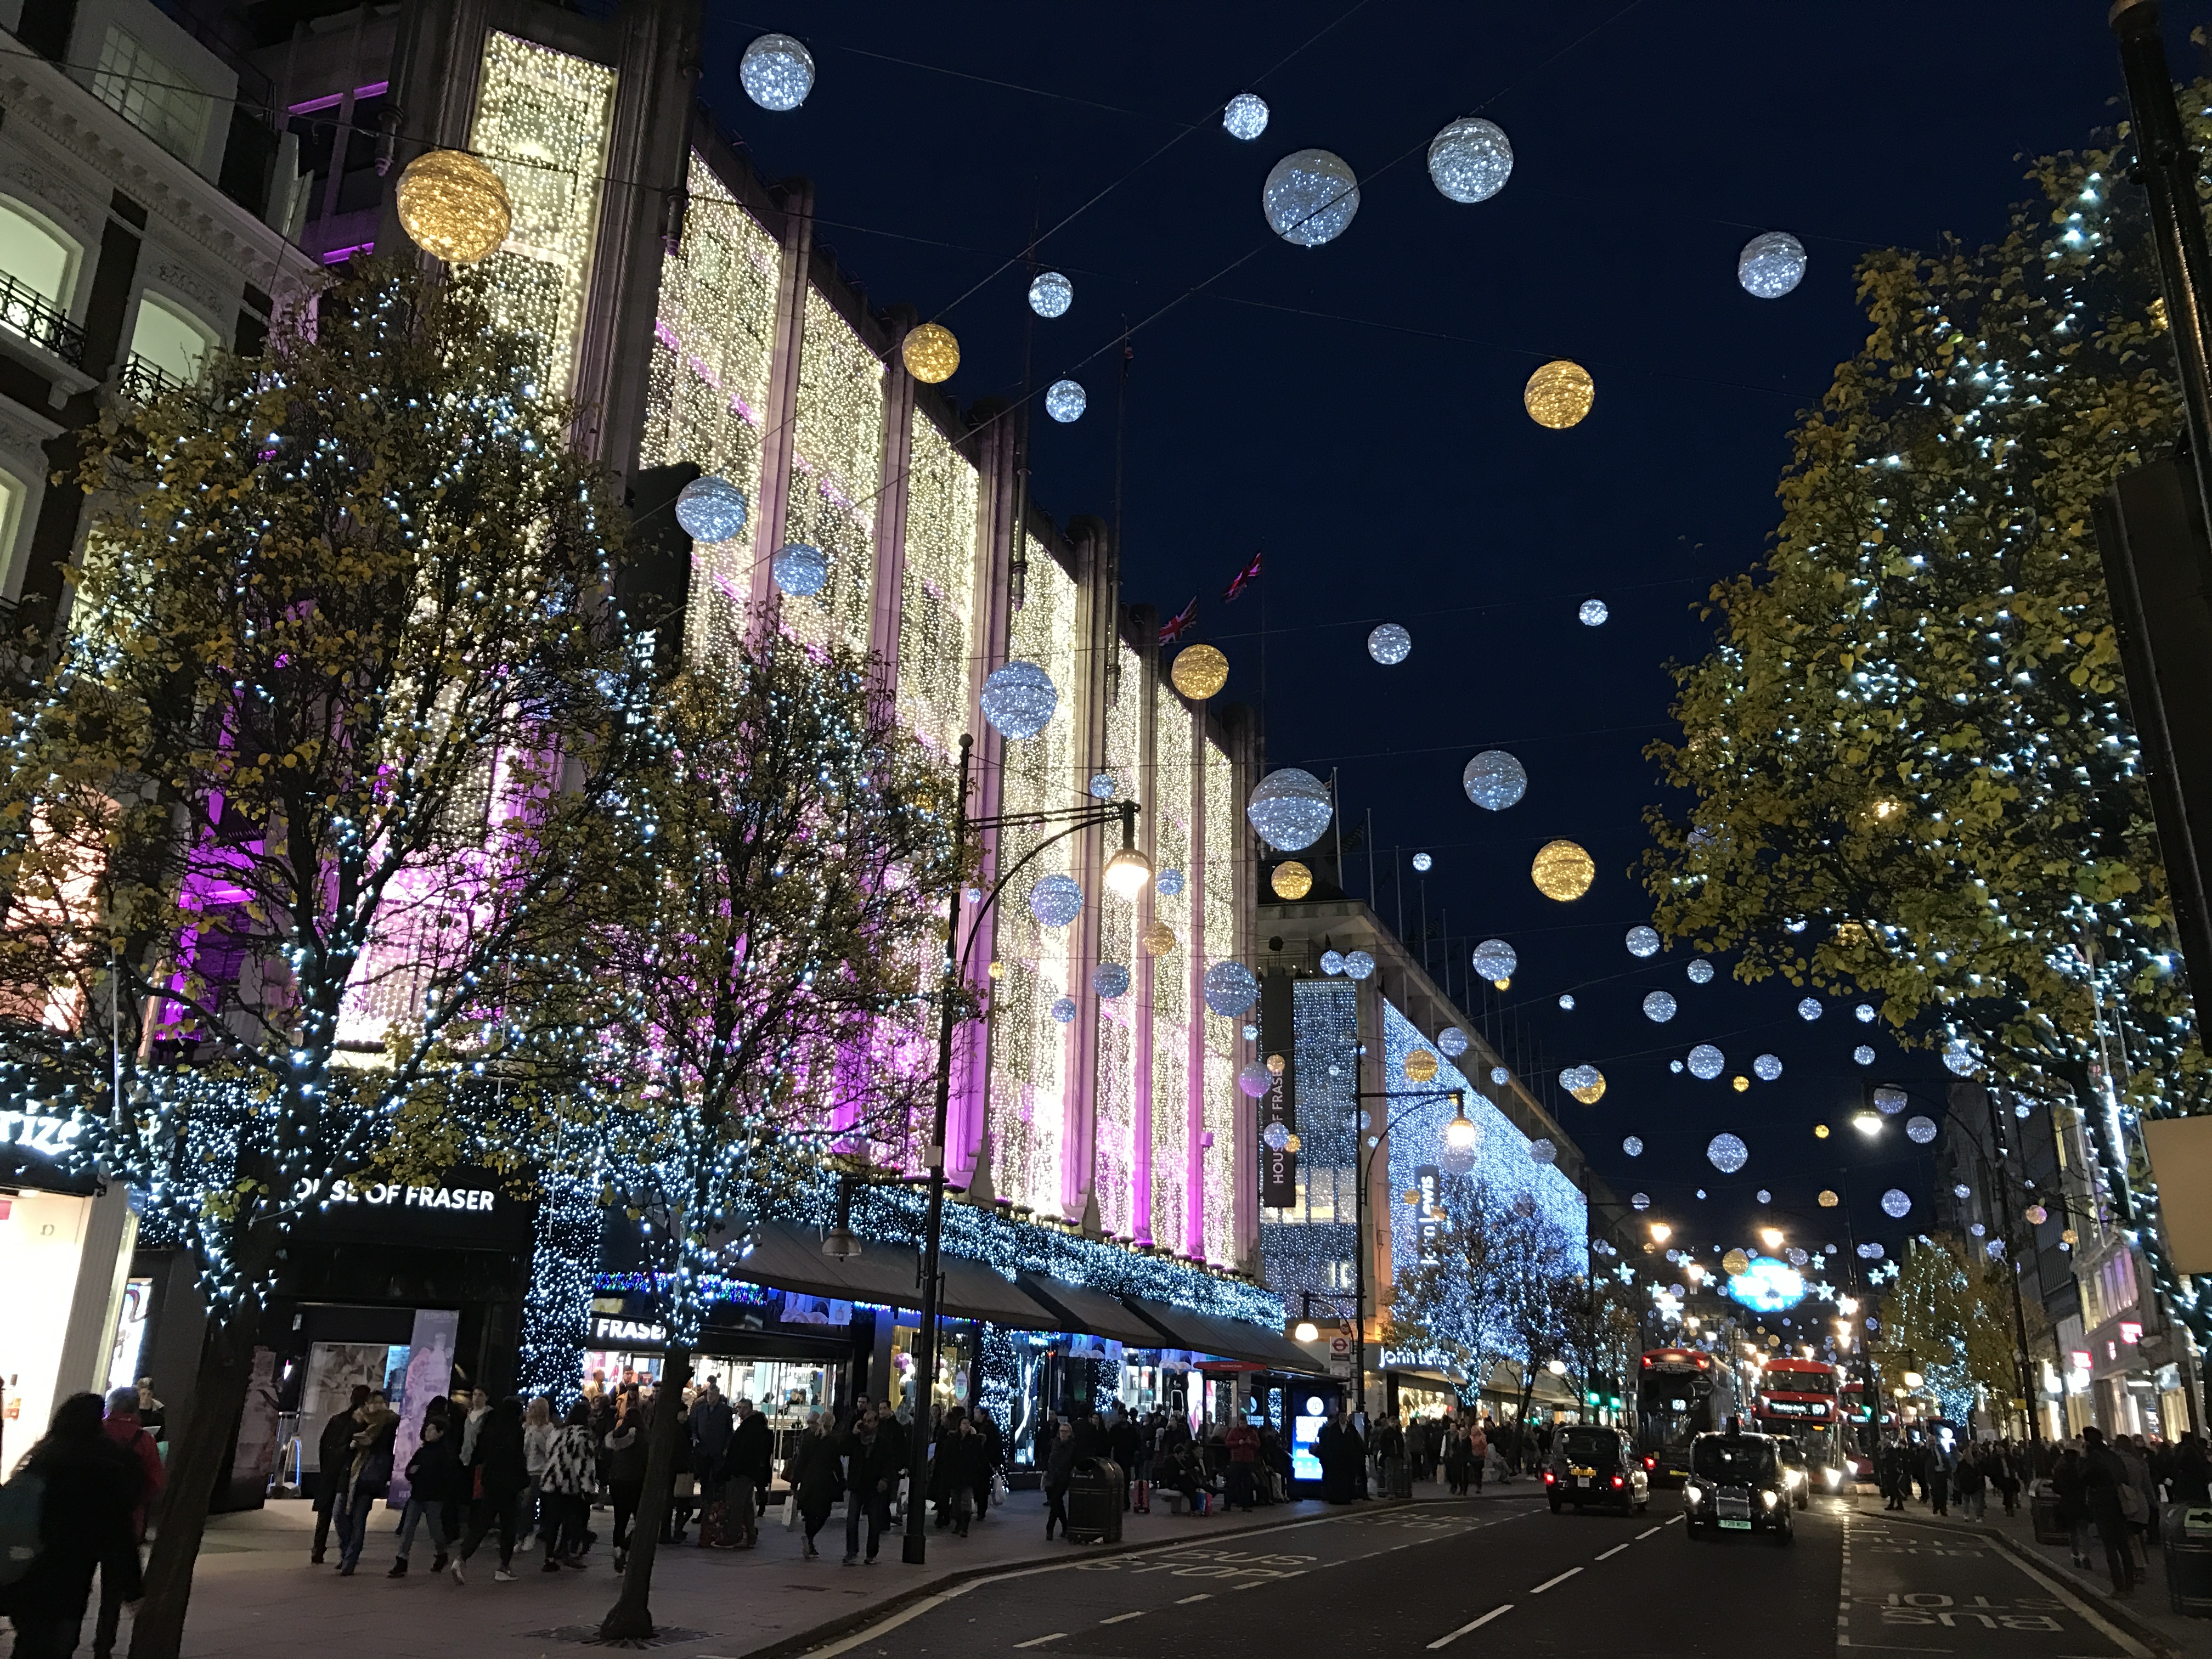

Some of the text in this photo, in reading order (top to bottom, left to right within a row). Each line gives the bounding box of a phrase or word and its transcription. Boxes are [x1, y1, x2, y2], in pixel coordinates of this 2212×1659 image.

[1272, 1069, 1283, 1110] FRASE
[1273, 1145, 1284, 1183] HOUS
[365, 1183, 401, 1205] OF
[404, 1185, 494, 1211] FRASER
[1672, 1399, 1686, 1411] 159
[1812, 1404, 1826, 1415] 159
[1880, 1415, 1889, 1424] 37
[1159, 1549, 1317, 1563] BUS
[1075, 1560, 1285, 1578] STOP
[1852, 1593, 2066, 1610] STOP
[1881, 1609, 2065, 1631] BUS
